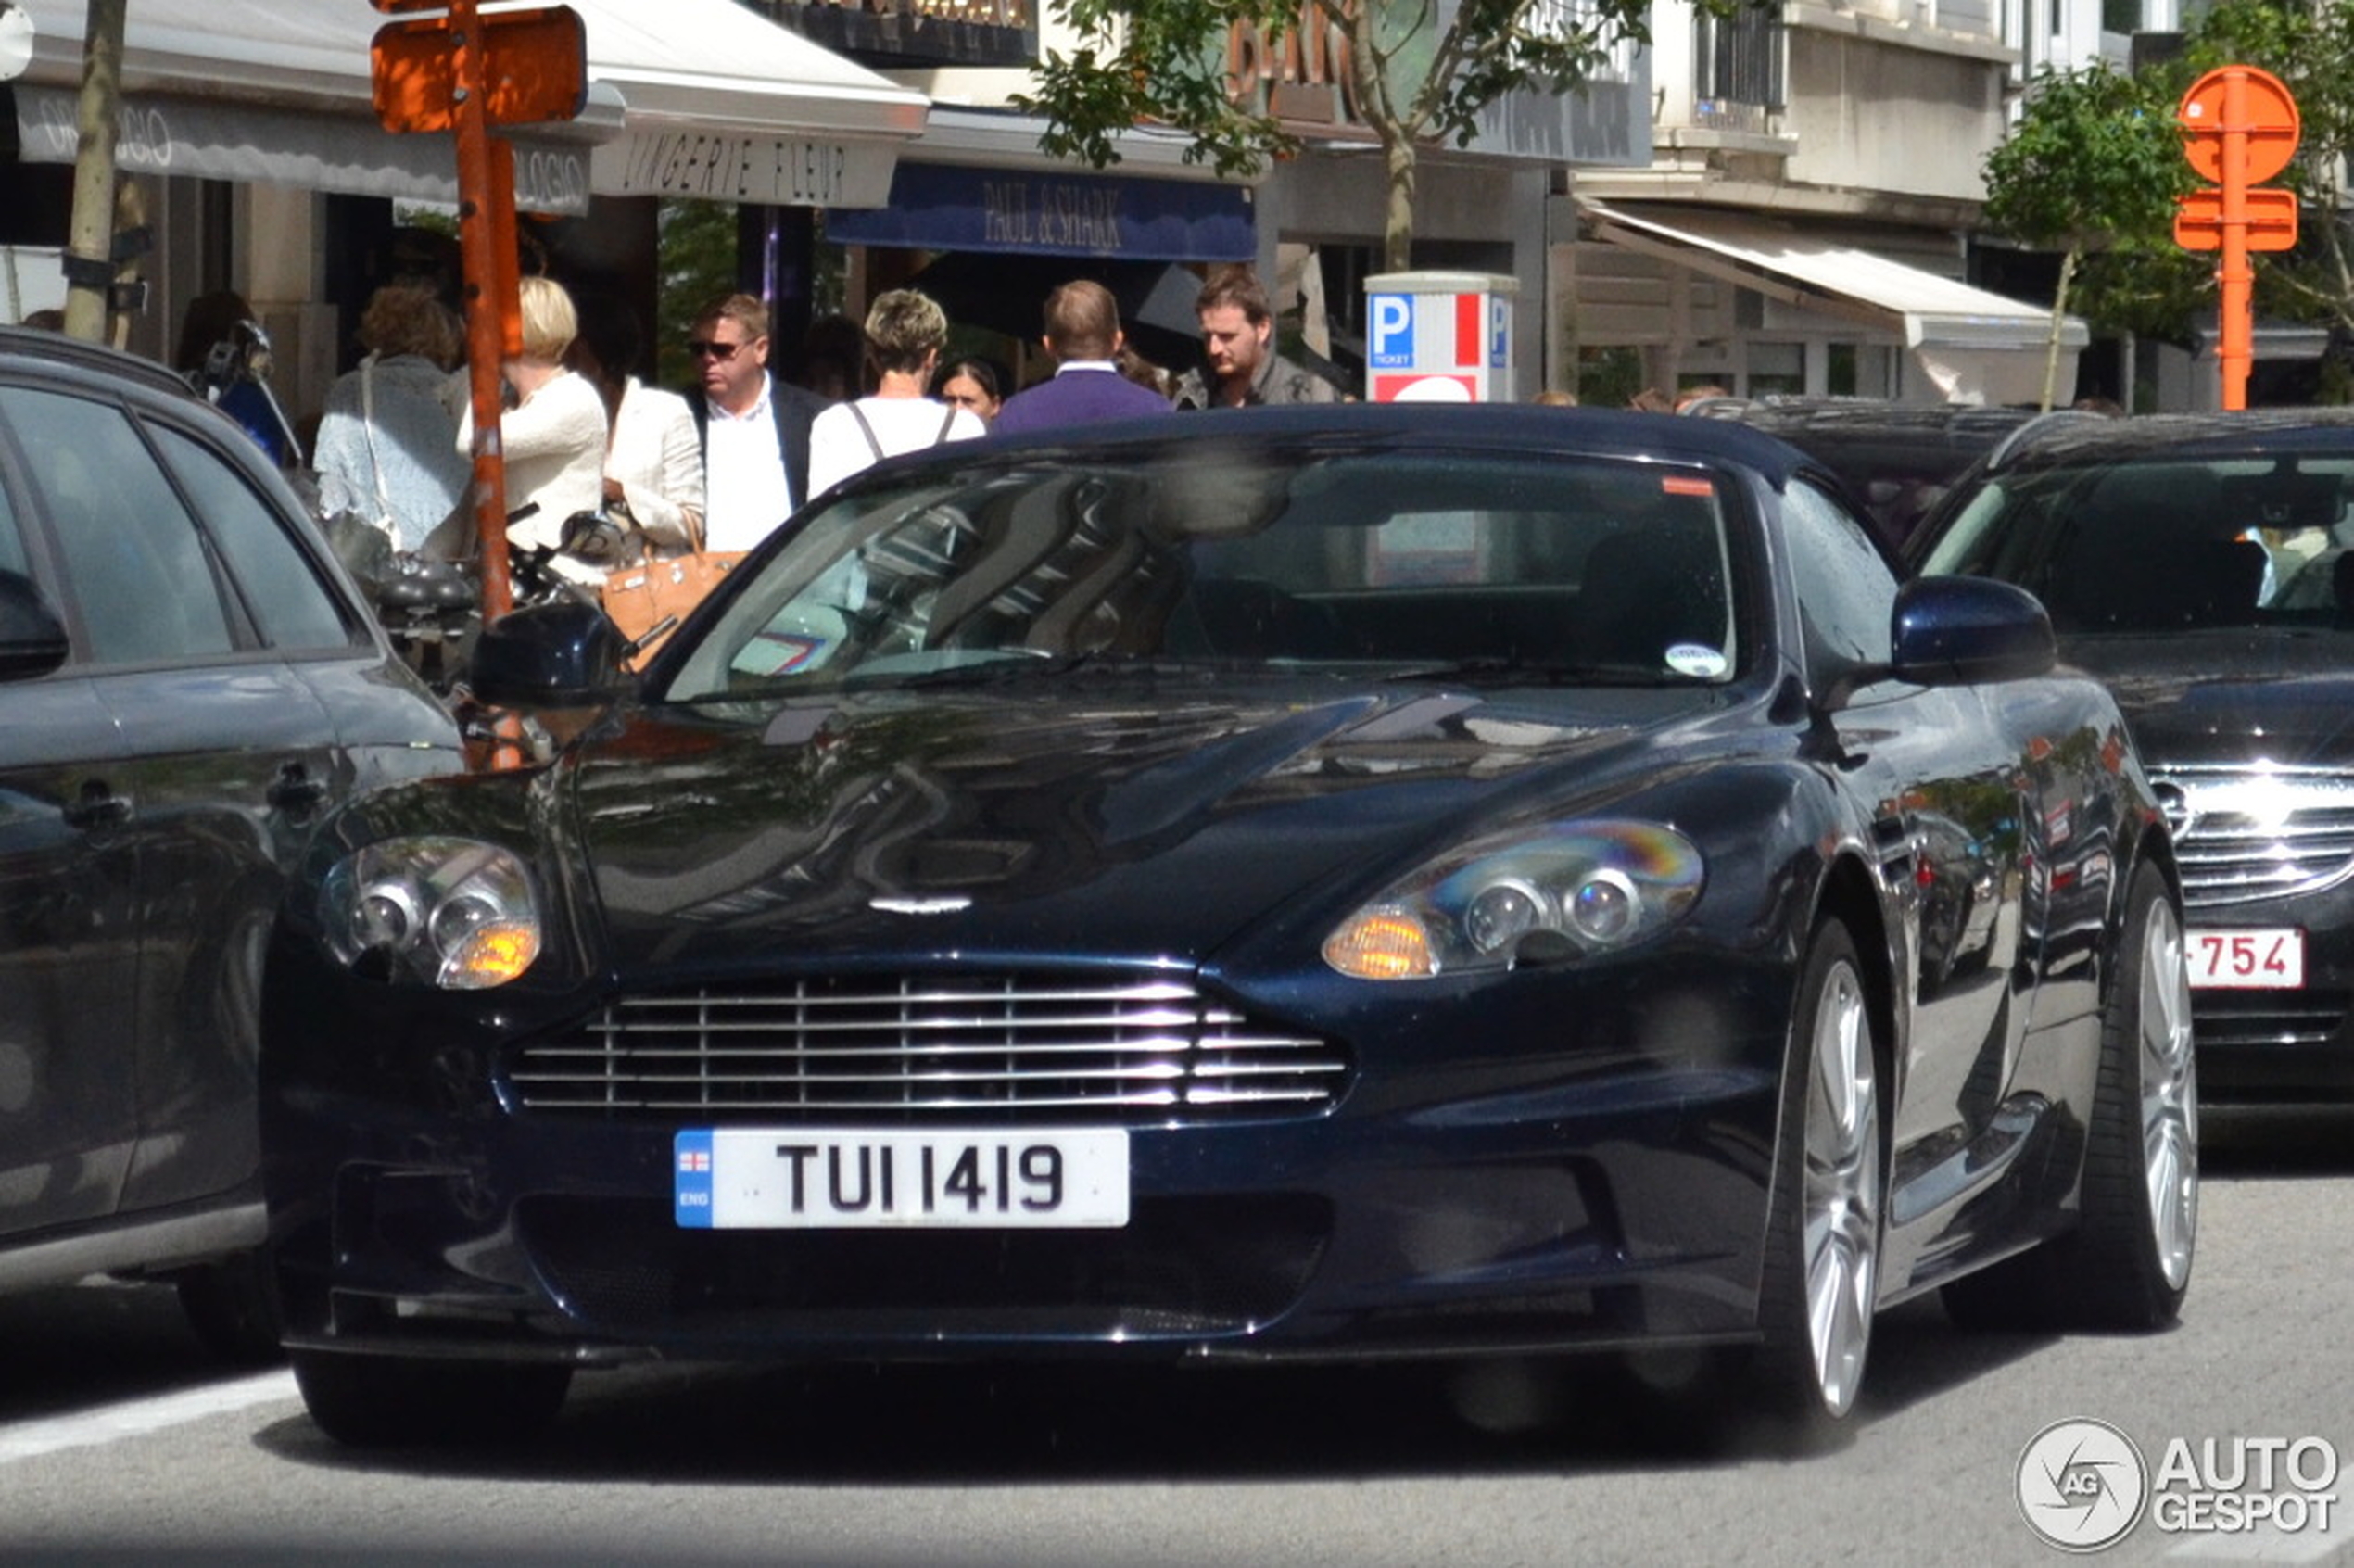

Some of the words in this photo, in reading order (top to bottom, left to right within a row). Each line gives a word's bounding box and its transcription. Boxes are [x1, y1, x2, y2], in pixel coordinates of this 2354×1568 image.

[625, 132, 752, 196] LINGERIE
[774, 142, 845, 203] FLEUR
[984, 182, 1033, 243] PAUL
[1038, 183, 1056, 245] &
[1056, 184, 1123, 249] SHARK
[1373, 296, 1411, 355] P
[679, 1193, 709, 1206] ENG
[776, 1144, 893, 1213] TUI
[921, 1144, 1064, 1213] 1419
